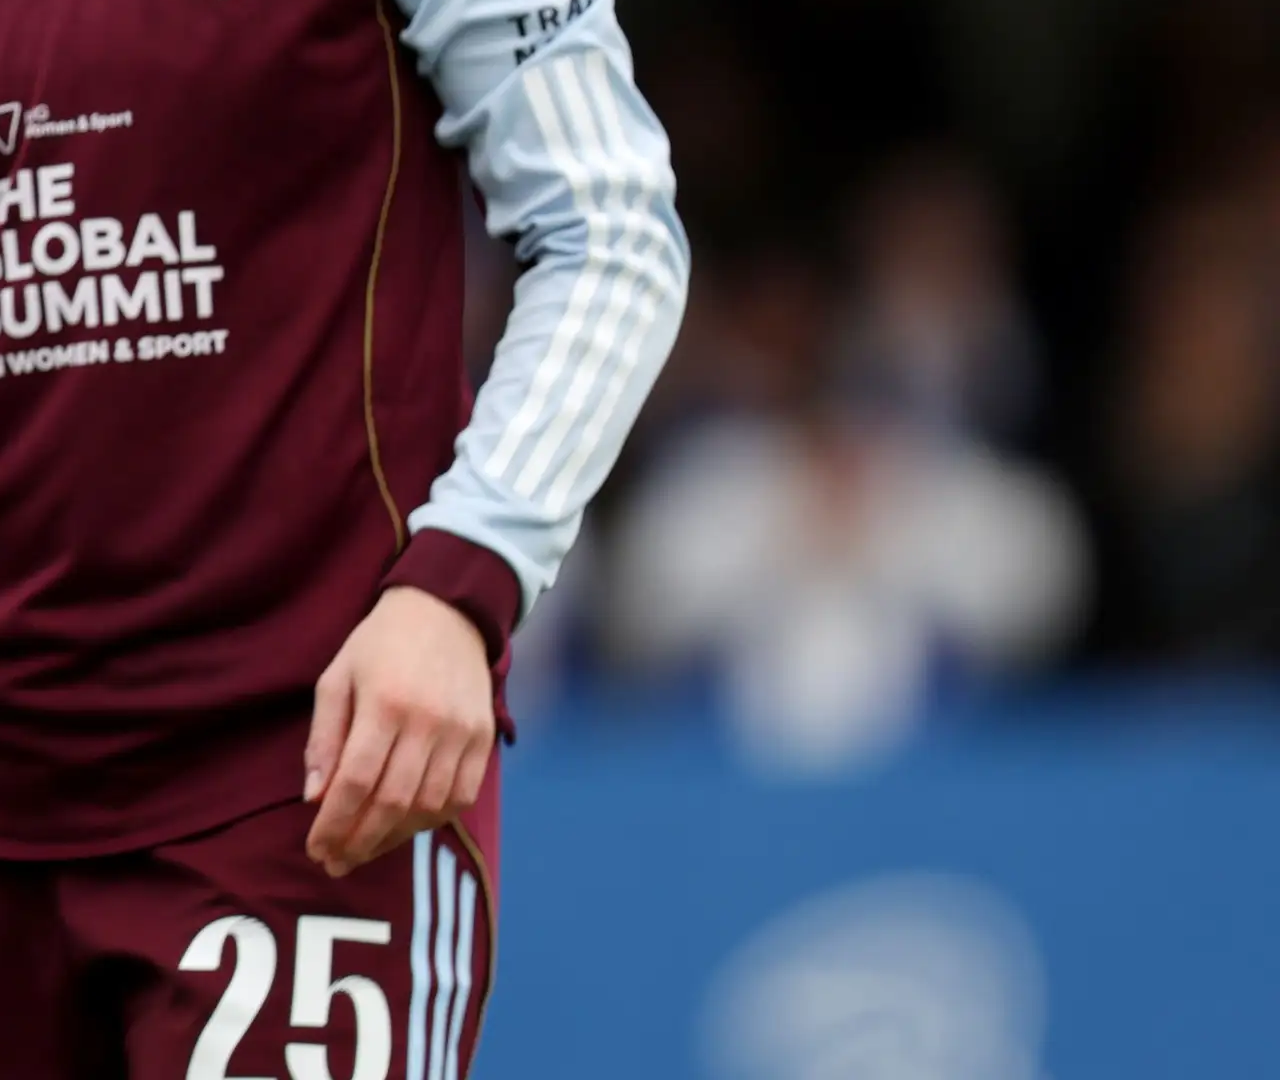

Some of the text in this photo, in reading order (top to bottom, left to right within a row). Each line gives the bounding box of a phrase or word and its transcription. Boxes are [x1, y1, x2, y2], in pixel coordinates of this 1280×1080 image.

[6, 338, 110, 376] WOMEN
[113, 336, 134, 363] &
[137, 328, 230, 361] SPORT
[178, 914, 392, 1080] 25
